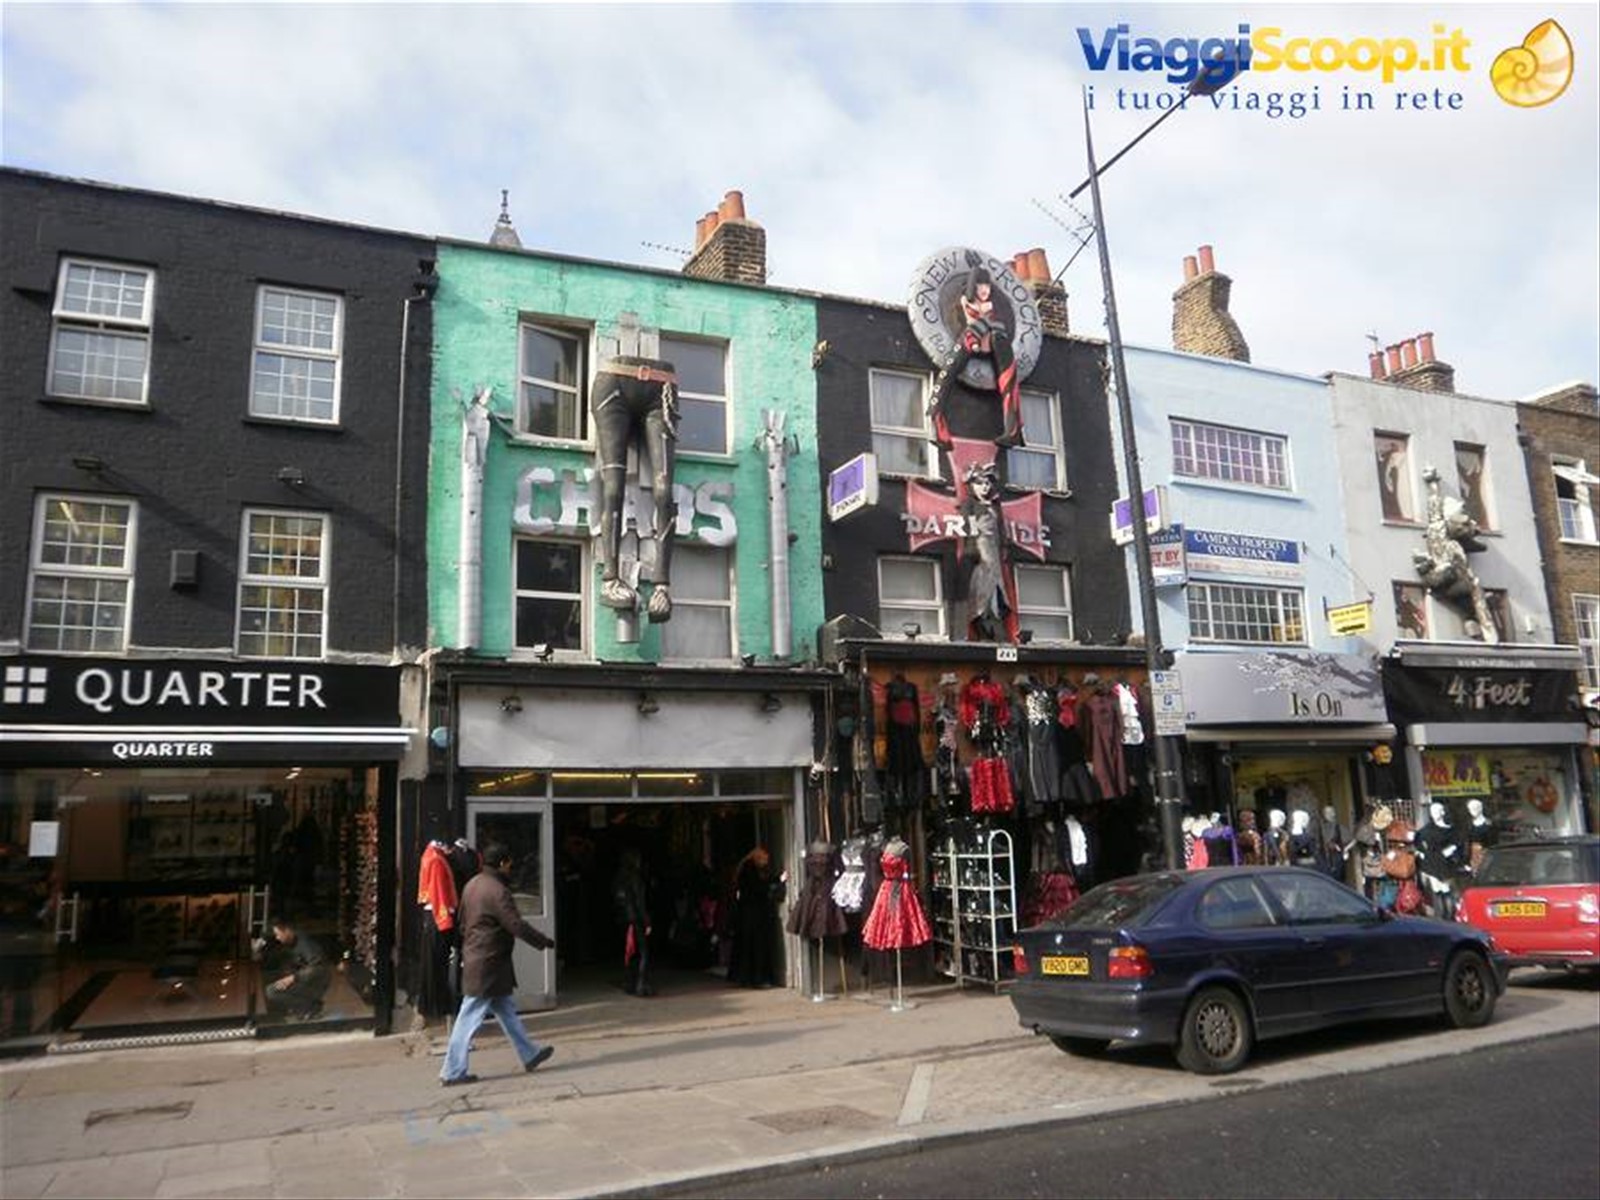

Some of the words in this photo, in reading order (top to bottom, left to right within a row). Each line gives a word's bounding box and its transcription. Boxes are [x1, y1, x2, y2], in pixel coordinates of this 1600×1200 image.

[900, 512, 1051, 548] DARKIDE
[75, 668, 327, 713] QUARTER
[1291, 691, 1310, 716] Is
[1316, 691, 1343, 717] On
[1474, 676, 1533, 709] Feet
[112, 742, 214, 758] QUARTER
